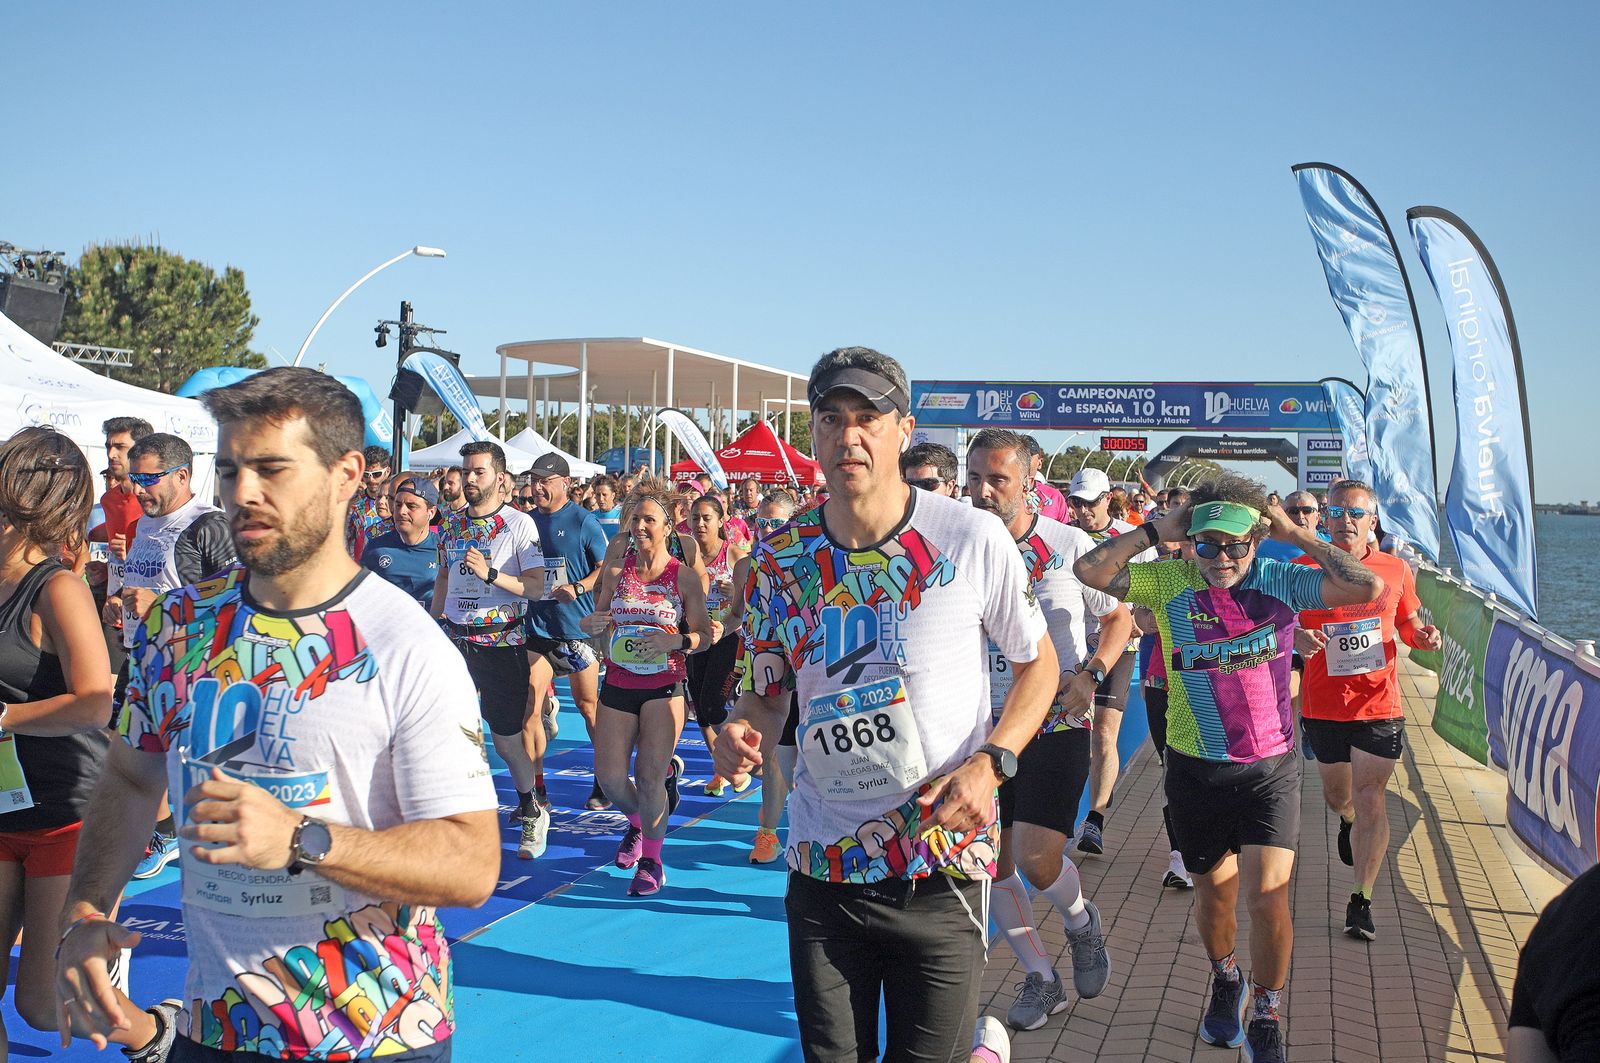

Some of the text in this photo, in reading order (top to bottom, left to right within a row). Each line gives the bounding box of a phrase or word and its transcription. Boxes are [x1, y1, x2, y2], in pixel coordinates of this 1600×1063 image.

[1058, 388, 1156, 400] CAMPEONATO
[1057, 400, 1190, 417] de ESPAÑA 10 km
[1229, 397, 1270, 411] HUELVA
[1305, 400, 1338, 413] WiH
[1020, 411, 1040, 419] WiHu
[1104, 416, 1119, 424] ruta
[1121, 416, 1155, 424] Absoluto
[1163, 417, 1190, 425] Master
[458, 600, 478, 610] WiHu
[658, 610, 676, 619] FIT
[1361, 621, 1376, 631] 2023
[1339, 634, 1370, 652] 890
[860, 686, 894, 707] 2023
[813, 712, 896, 756] 1868
[850, 755, 870, 766] JUAN
[858, 777, 889, 791] Syrluz
[269, 782, 316, 803] 2023
[218, 868, 293, 885] RECIO SENDRA
[240, 891, 284, 907] Syrluz
